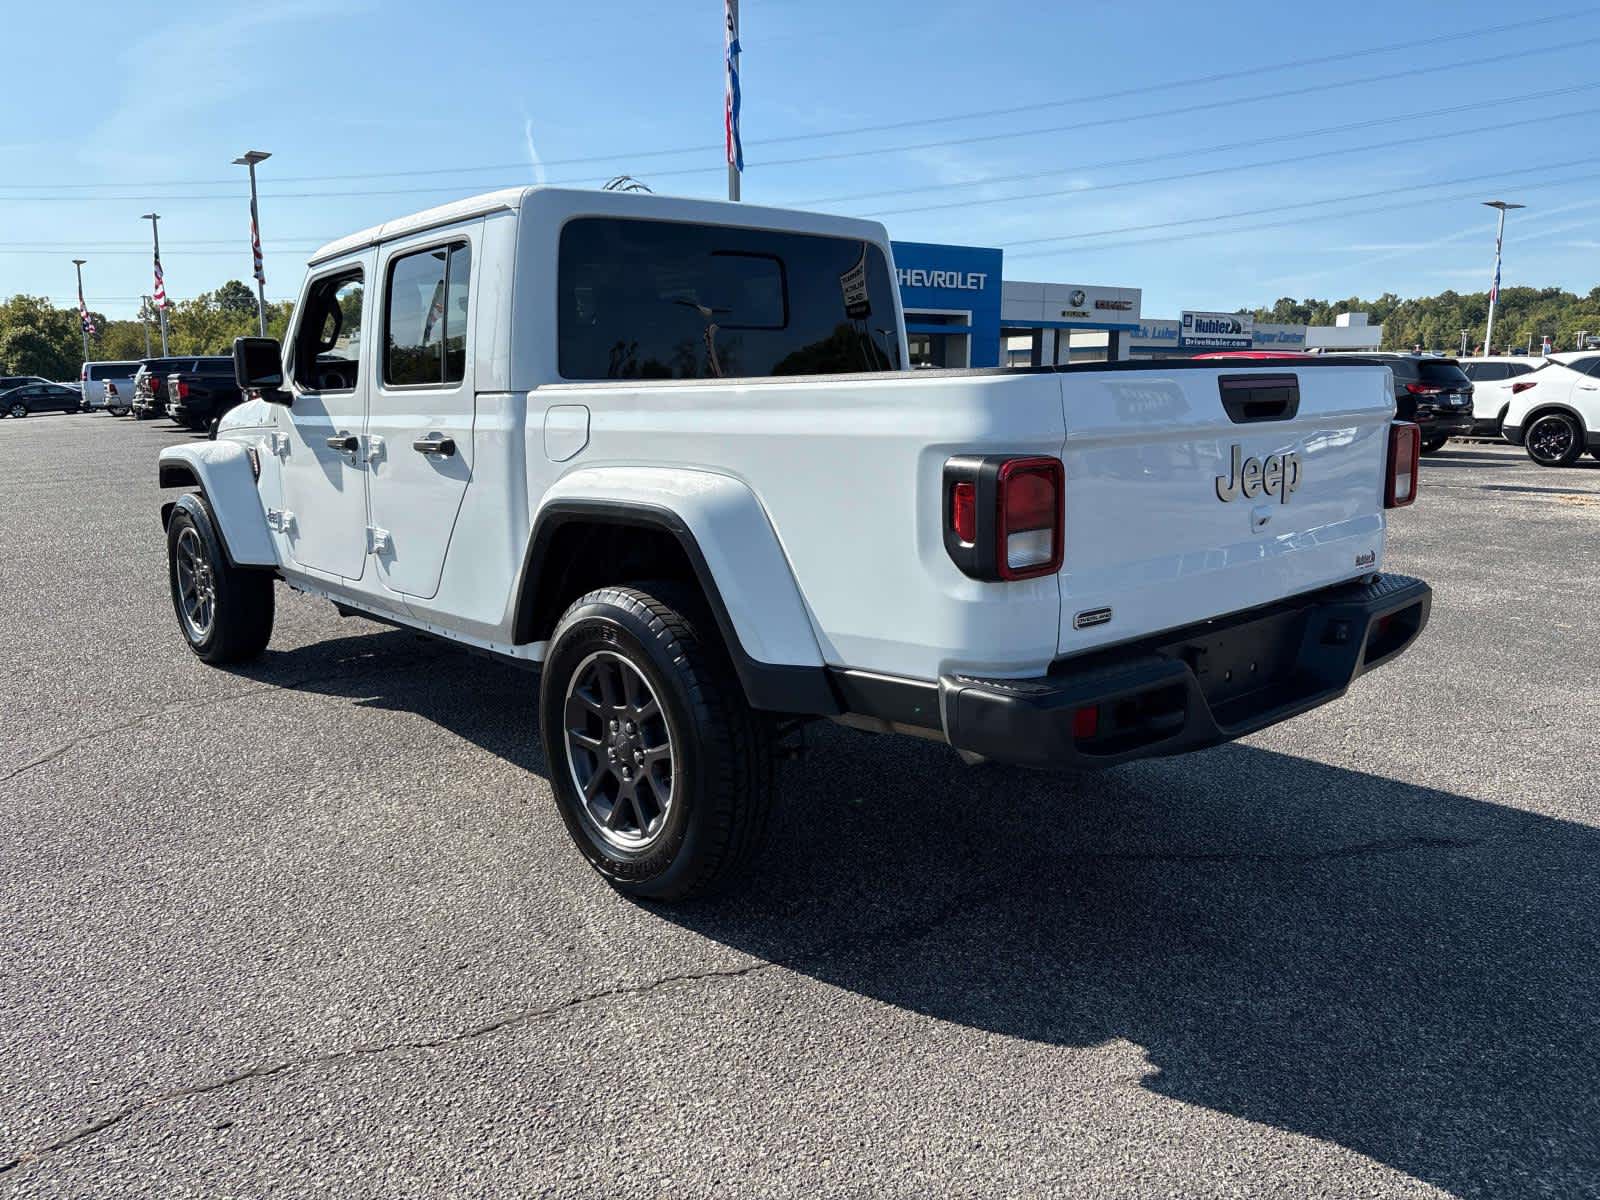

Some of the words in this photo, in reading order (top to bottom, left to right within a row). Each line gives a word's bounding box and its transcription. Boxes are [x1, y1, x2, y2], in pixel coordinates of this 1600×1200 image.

[896, 268, 988, 290] HEVROLET
[1195, 318, 1231, 334] Hubler
[1185, 337, 1248, 347] DriveHubler.com
[1215, 443, 1303, 505] Jeep
